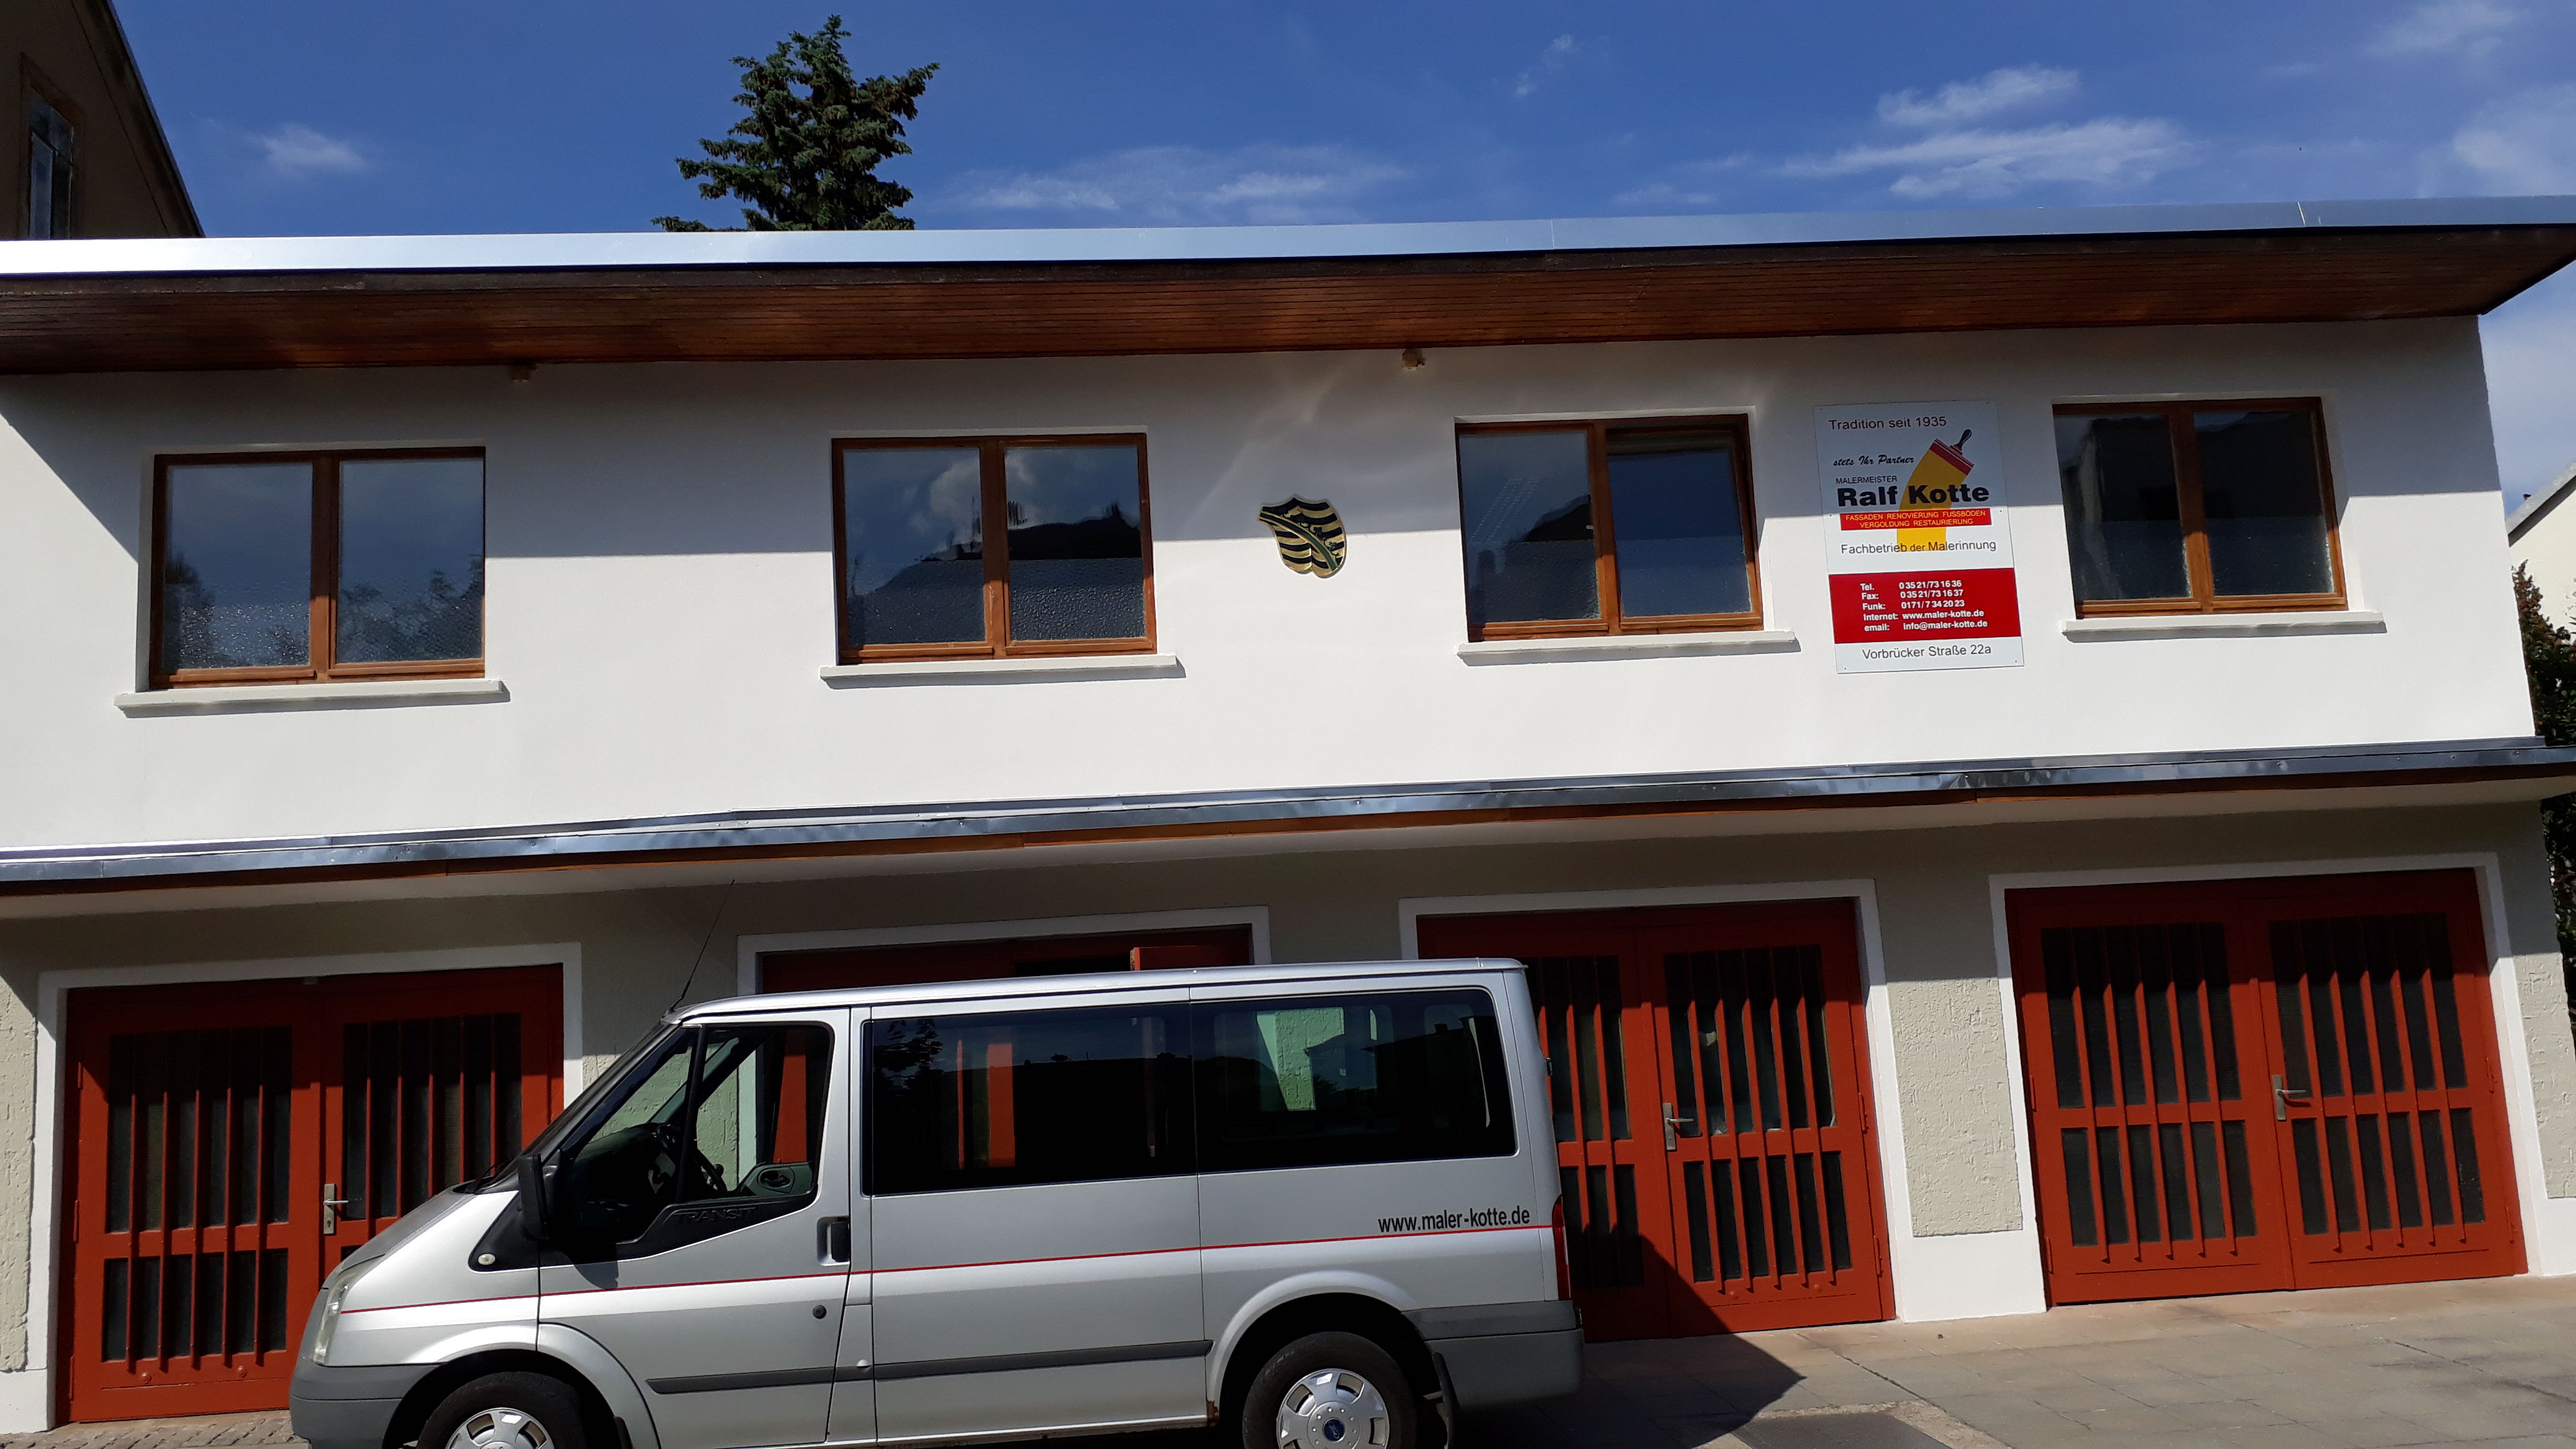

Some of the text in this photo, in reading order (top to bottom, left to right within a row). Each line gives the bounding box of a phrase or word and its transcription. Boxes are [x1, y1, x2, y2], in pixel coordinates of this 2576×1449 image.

[1829, 416, 1946, 430] Tradition seit 1935
[1858, 456, 1874, 465] Ihr
[1878, 454, 1915, 464] Partner
[1835, 476, 1897, 484] MALERMEISTER
[1837, 484, 1989, 507] Ralf Kotte
[1841, 540, 1996, 554] Fachbetrieb der Malerinnung
[1860, 583, 1875, 591] Tel.
[1861, 592, 1879, 600] Fax:
[1862, 602, 1886, 610] Funk:
[1863, 609, 1984, 621] Internet: www.maler-kotte.de
[1864, 623, 1890, 632] email:
[1862, 644, 1991, 660] Vorbrücker Straße 22a
[1378, 1205, 1530, 1233] www.maler-kotte.de
